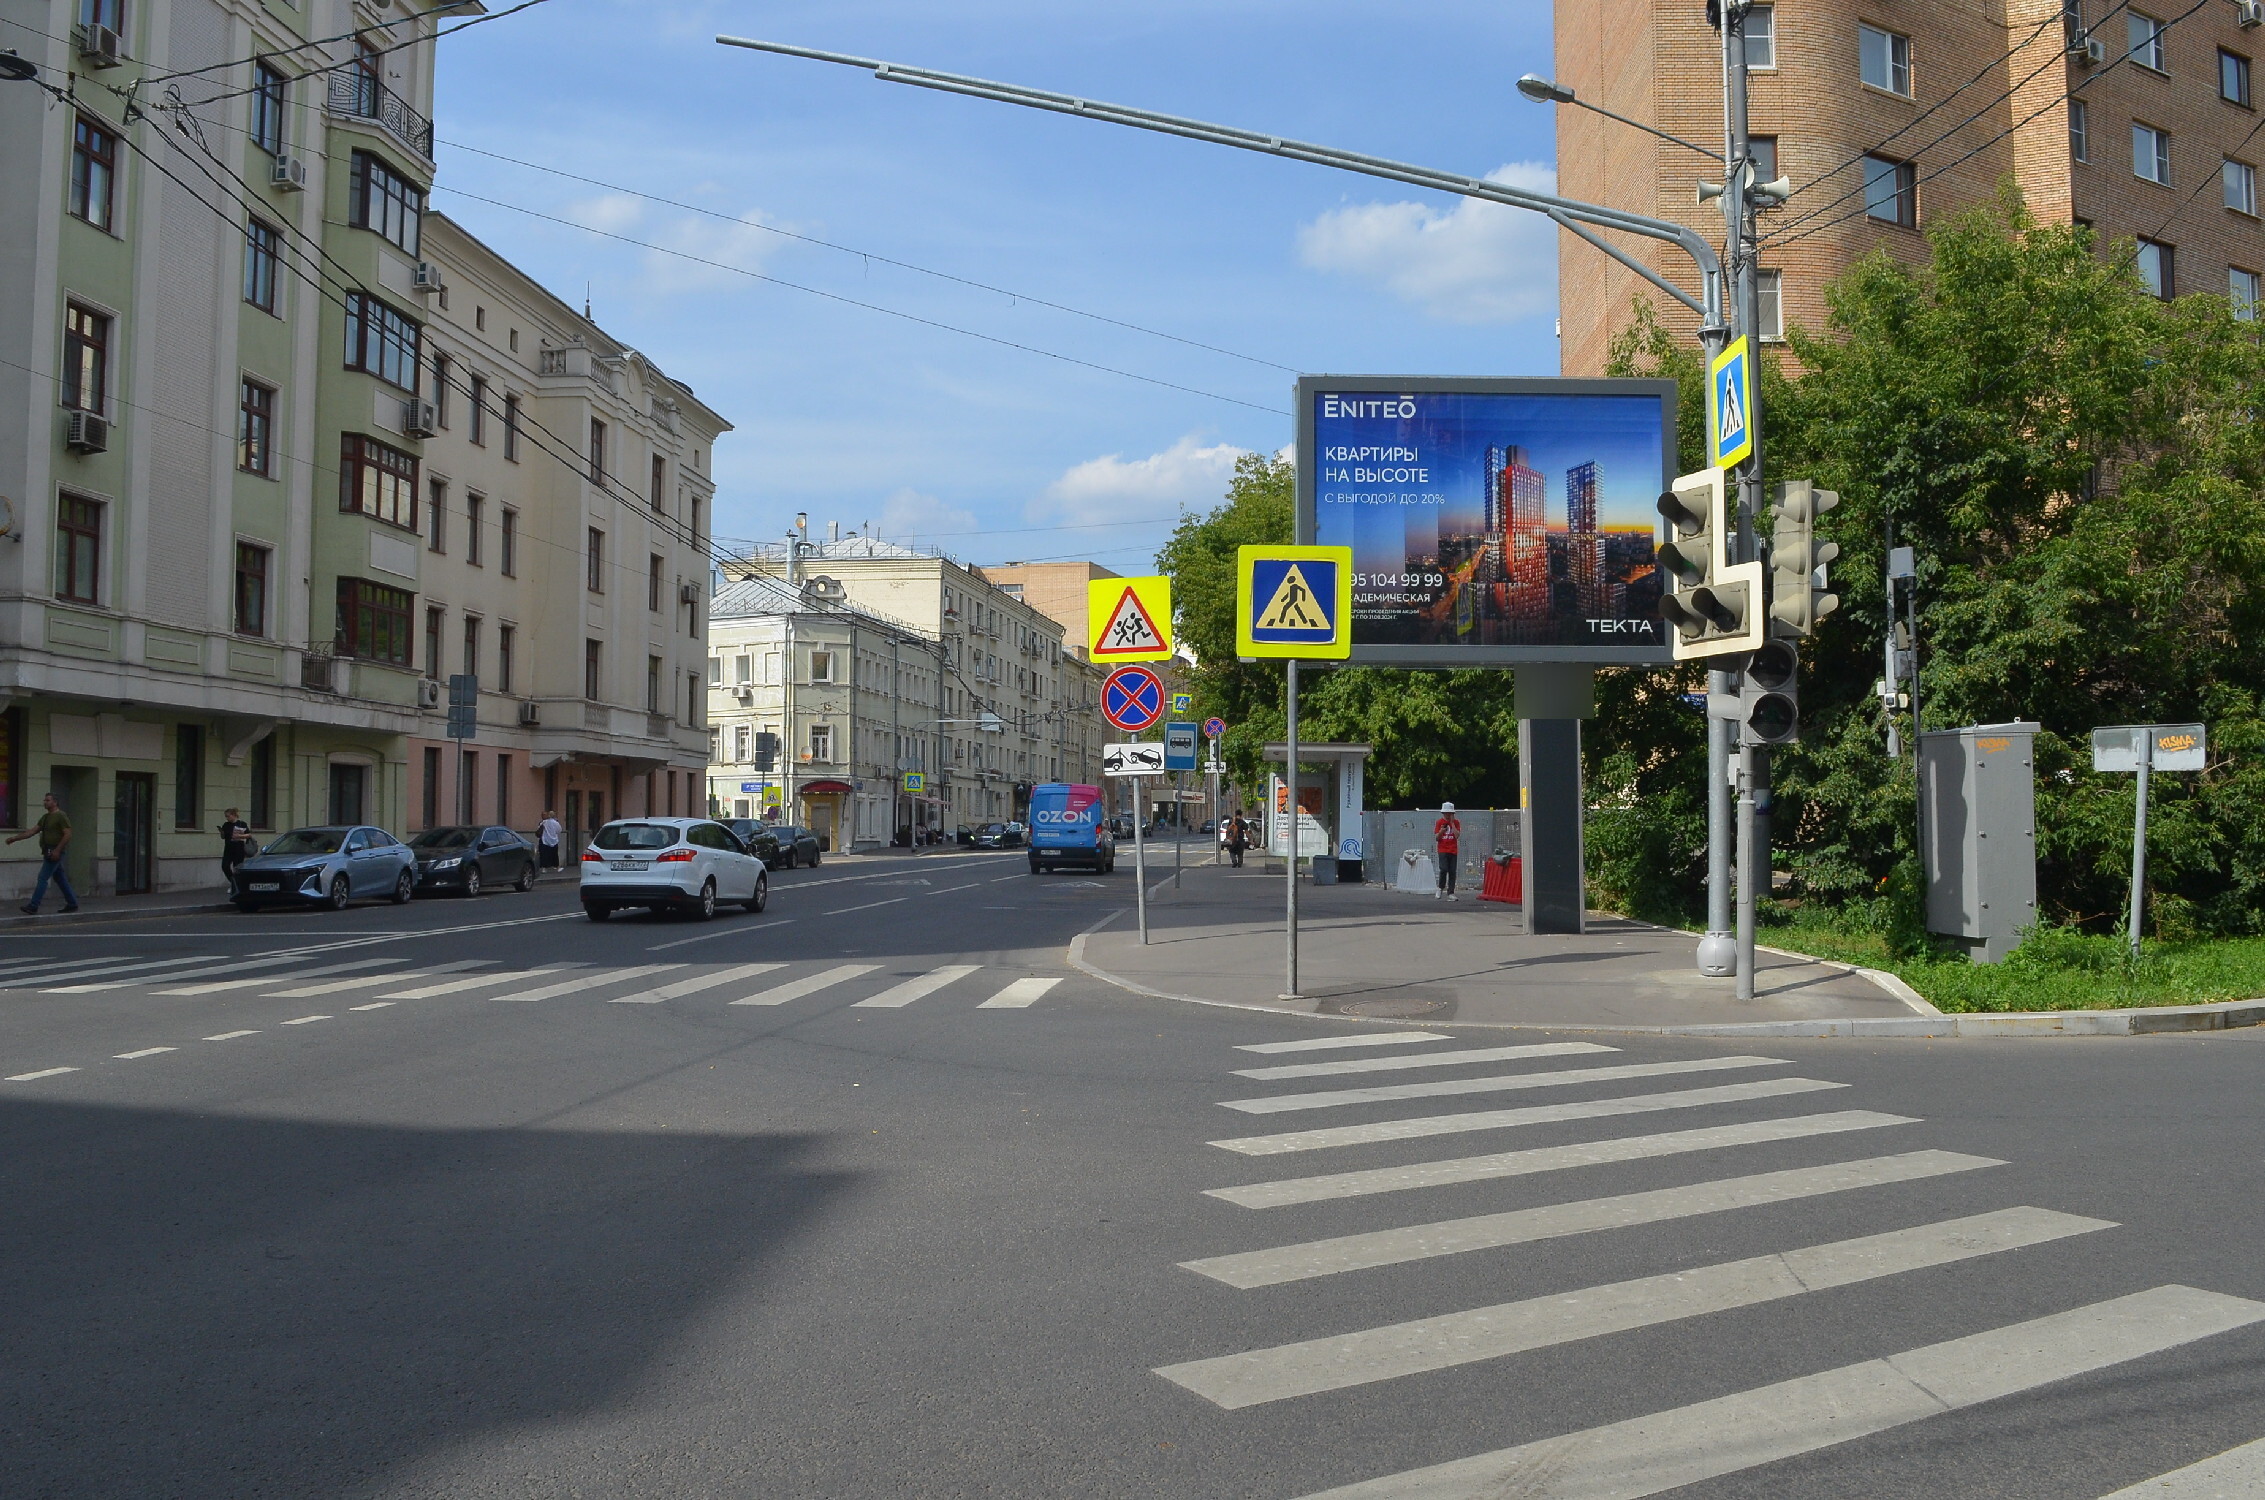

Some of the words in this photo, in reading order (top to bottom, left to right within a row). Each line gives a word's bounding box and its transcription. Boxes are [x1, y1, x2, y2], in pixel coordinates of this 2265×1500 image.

[1325, 447, 1418, 461] КВАРТИРЫ
[1325, 468, 1350, 482] НА
[1354, 468, 1429, 482] ВЫСОТЕ
[1325, 493, 1334, 503] С
[1337, 492, 1396, 504] ВЫГОДОЙ
[1400, 494, 1418, 505] ДО
[1421, 494, 1445, 504] 20%
[1351, 573, 1367, 586] 95
[1370, 573, 1397, 586] 104
[1400, 573, 1420, 586] 99
[1424, 573, 1443, 586] 99
[1351, 593, 1431, 603] АДЕМИЧЕСКАЯ
[1037, 810, 1092, 823] OZON
